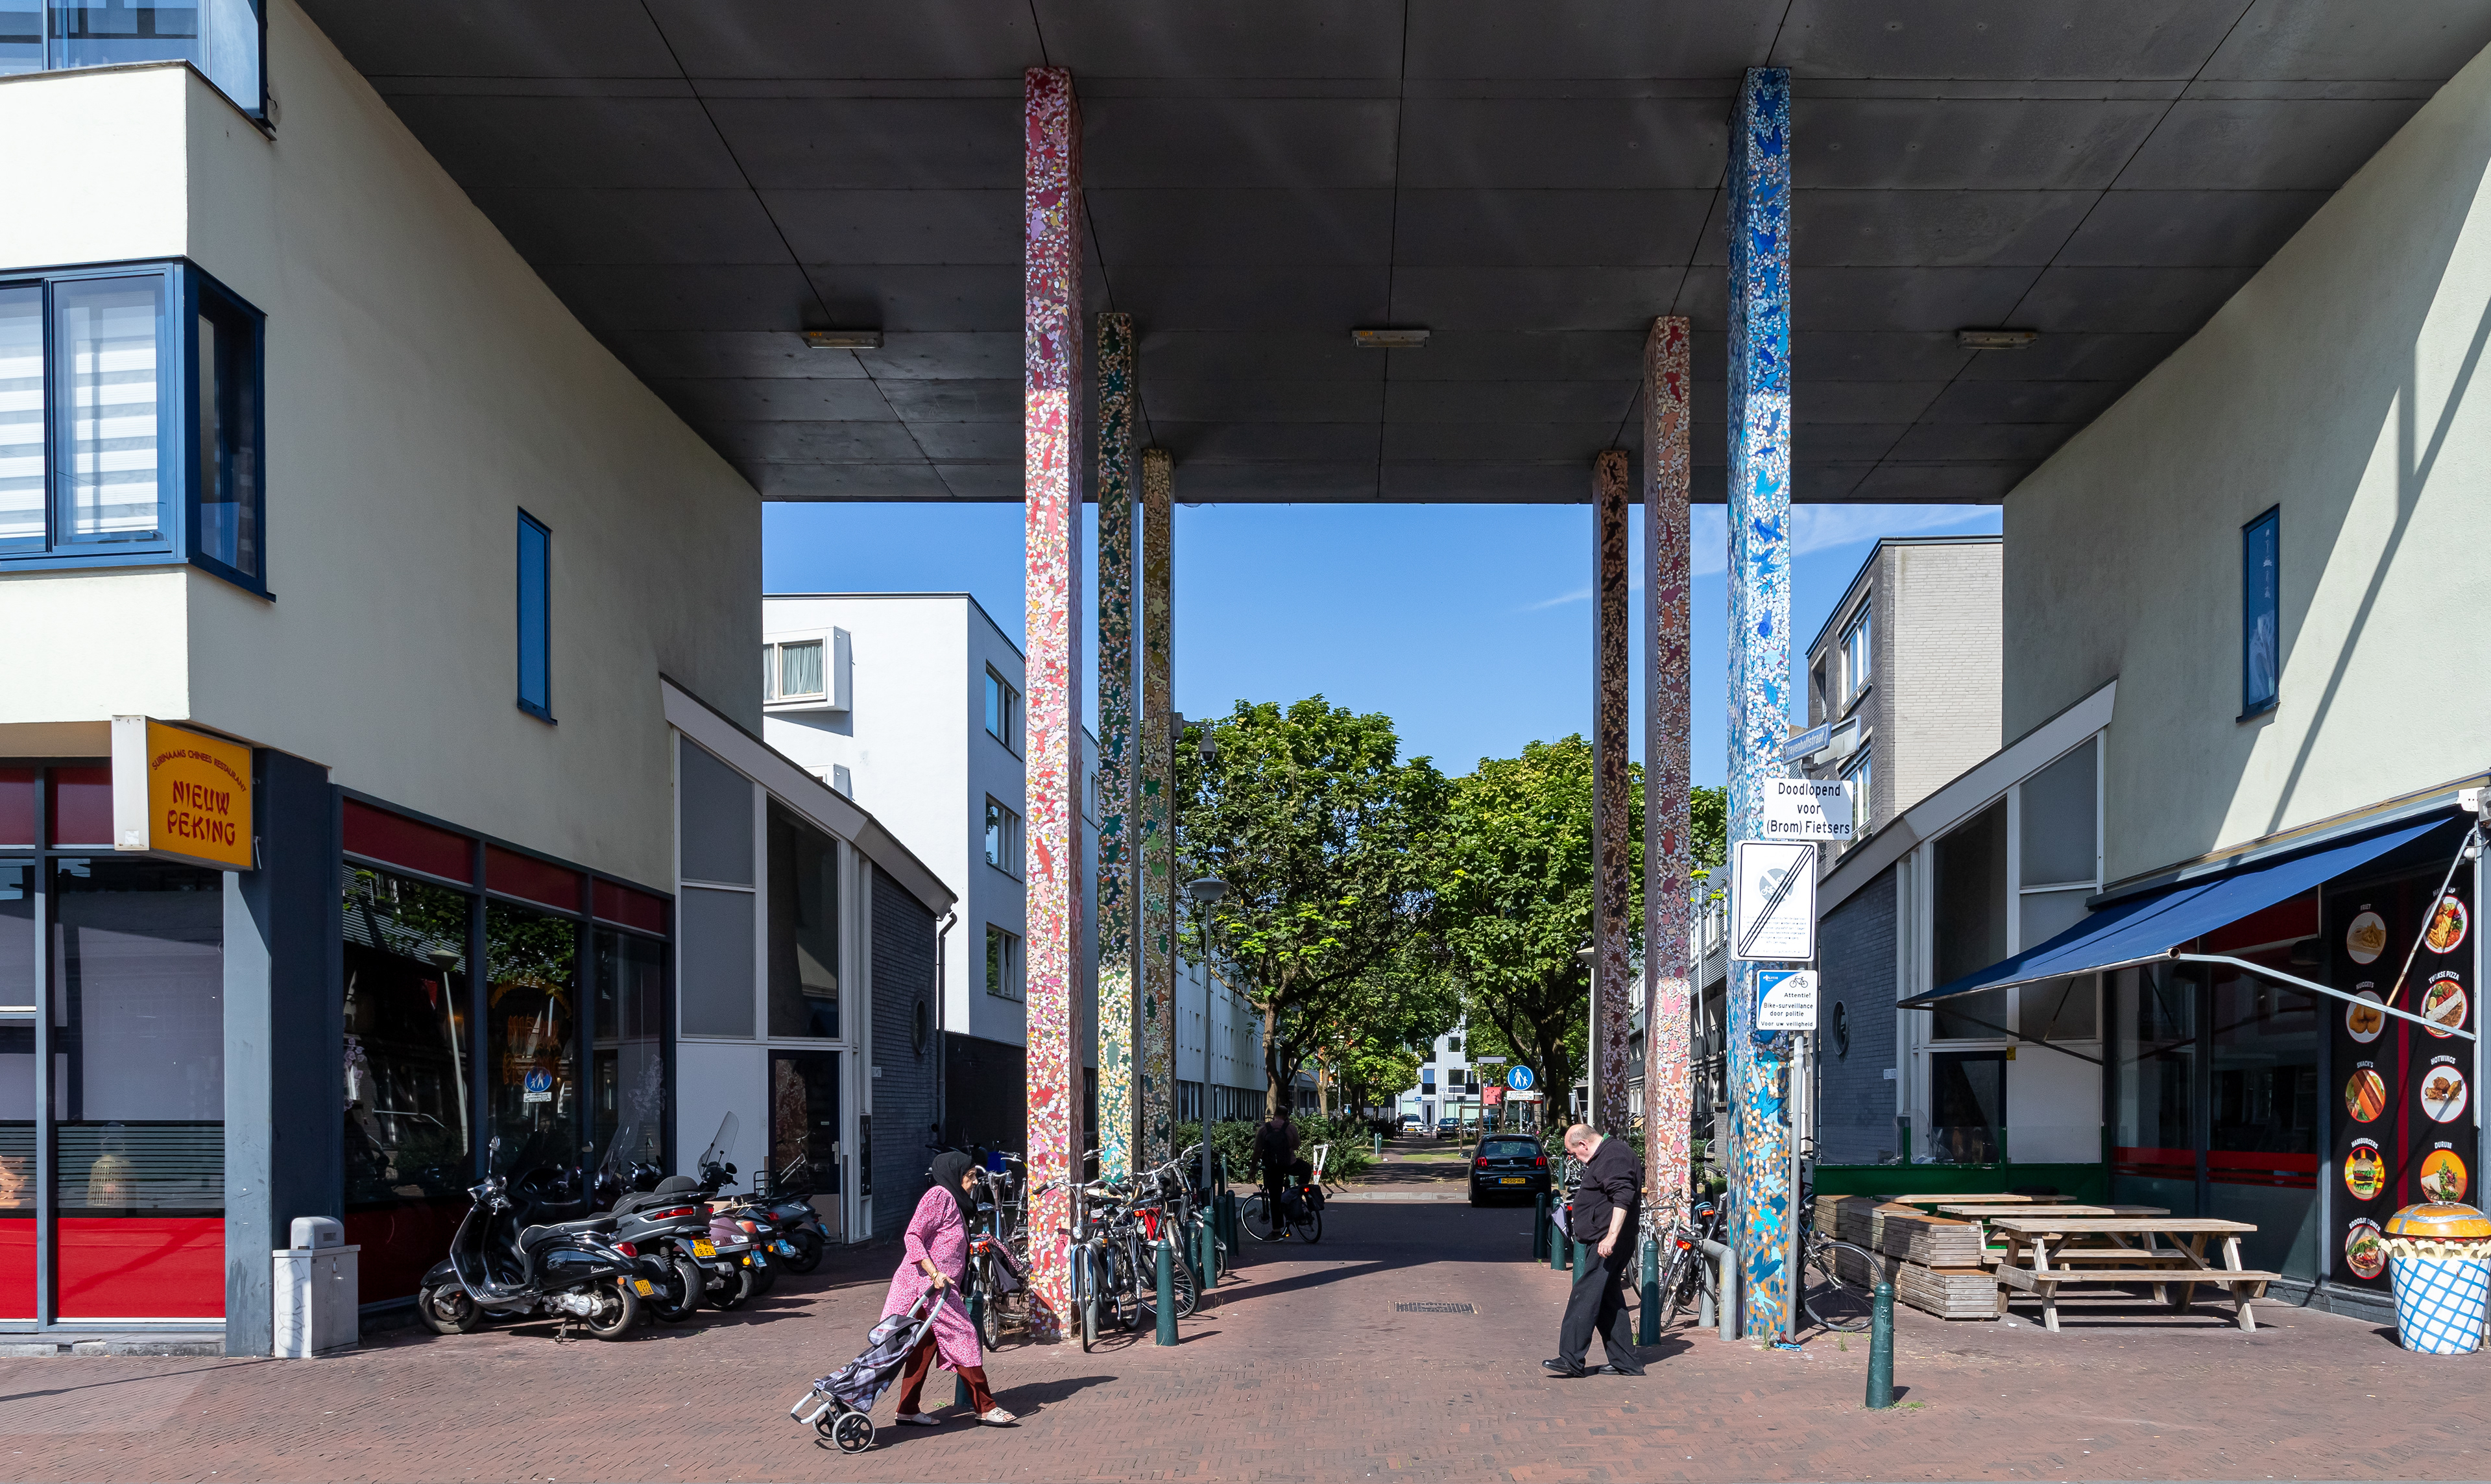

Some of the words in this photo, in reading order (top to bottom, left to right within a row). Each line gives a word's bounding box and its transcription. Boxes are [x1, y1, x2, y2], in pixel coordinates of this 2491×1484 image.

[152, 749, 186, 771] SURINAAMS
[188, 750, 212, 764] CHINEES
[214, 758, 247, 793] RESTAURANT
[1778, 782, 1841, 798] Doodlopend
[173, 780, 230, 816] NIEUW
[1797, 804, 1821, 814] voor
[167, 809, 235, 848] PEKING
[1766, 820, 1803, 835] (Brom)
[1805, 820, 1850, 834] Fietsers
[2428, 970, 2446, 984] TURKSE
[2446, 970, 2459, 981] PIZZA
[2355, 981, 2374, 990] NUGGETS
[2357, 1060, 2374, 1069] SNACK'S
[2431, 1055, 2456, 1065] HOTWINGS
[2351, 1138, 2379, 1150] HAMBURGERS
[2435, 1141, 2452, 1149] DURUM
[2349, 1217, 2367, 1230] BROODJE
